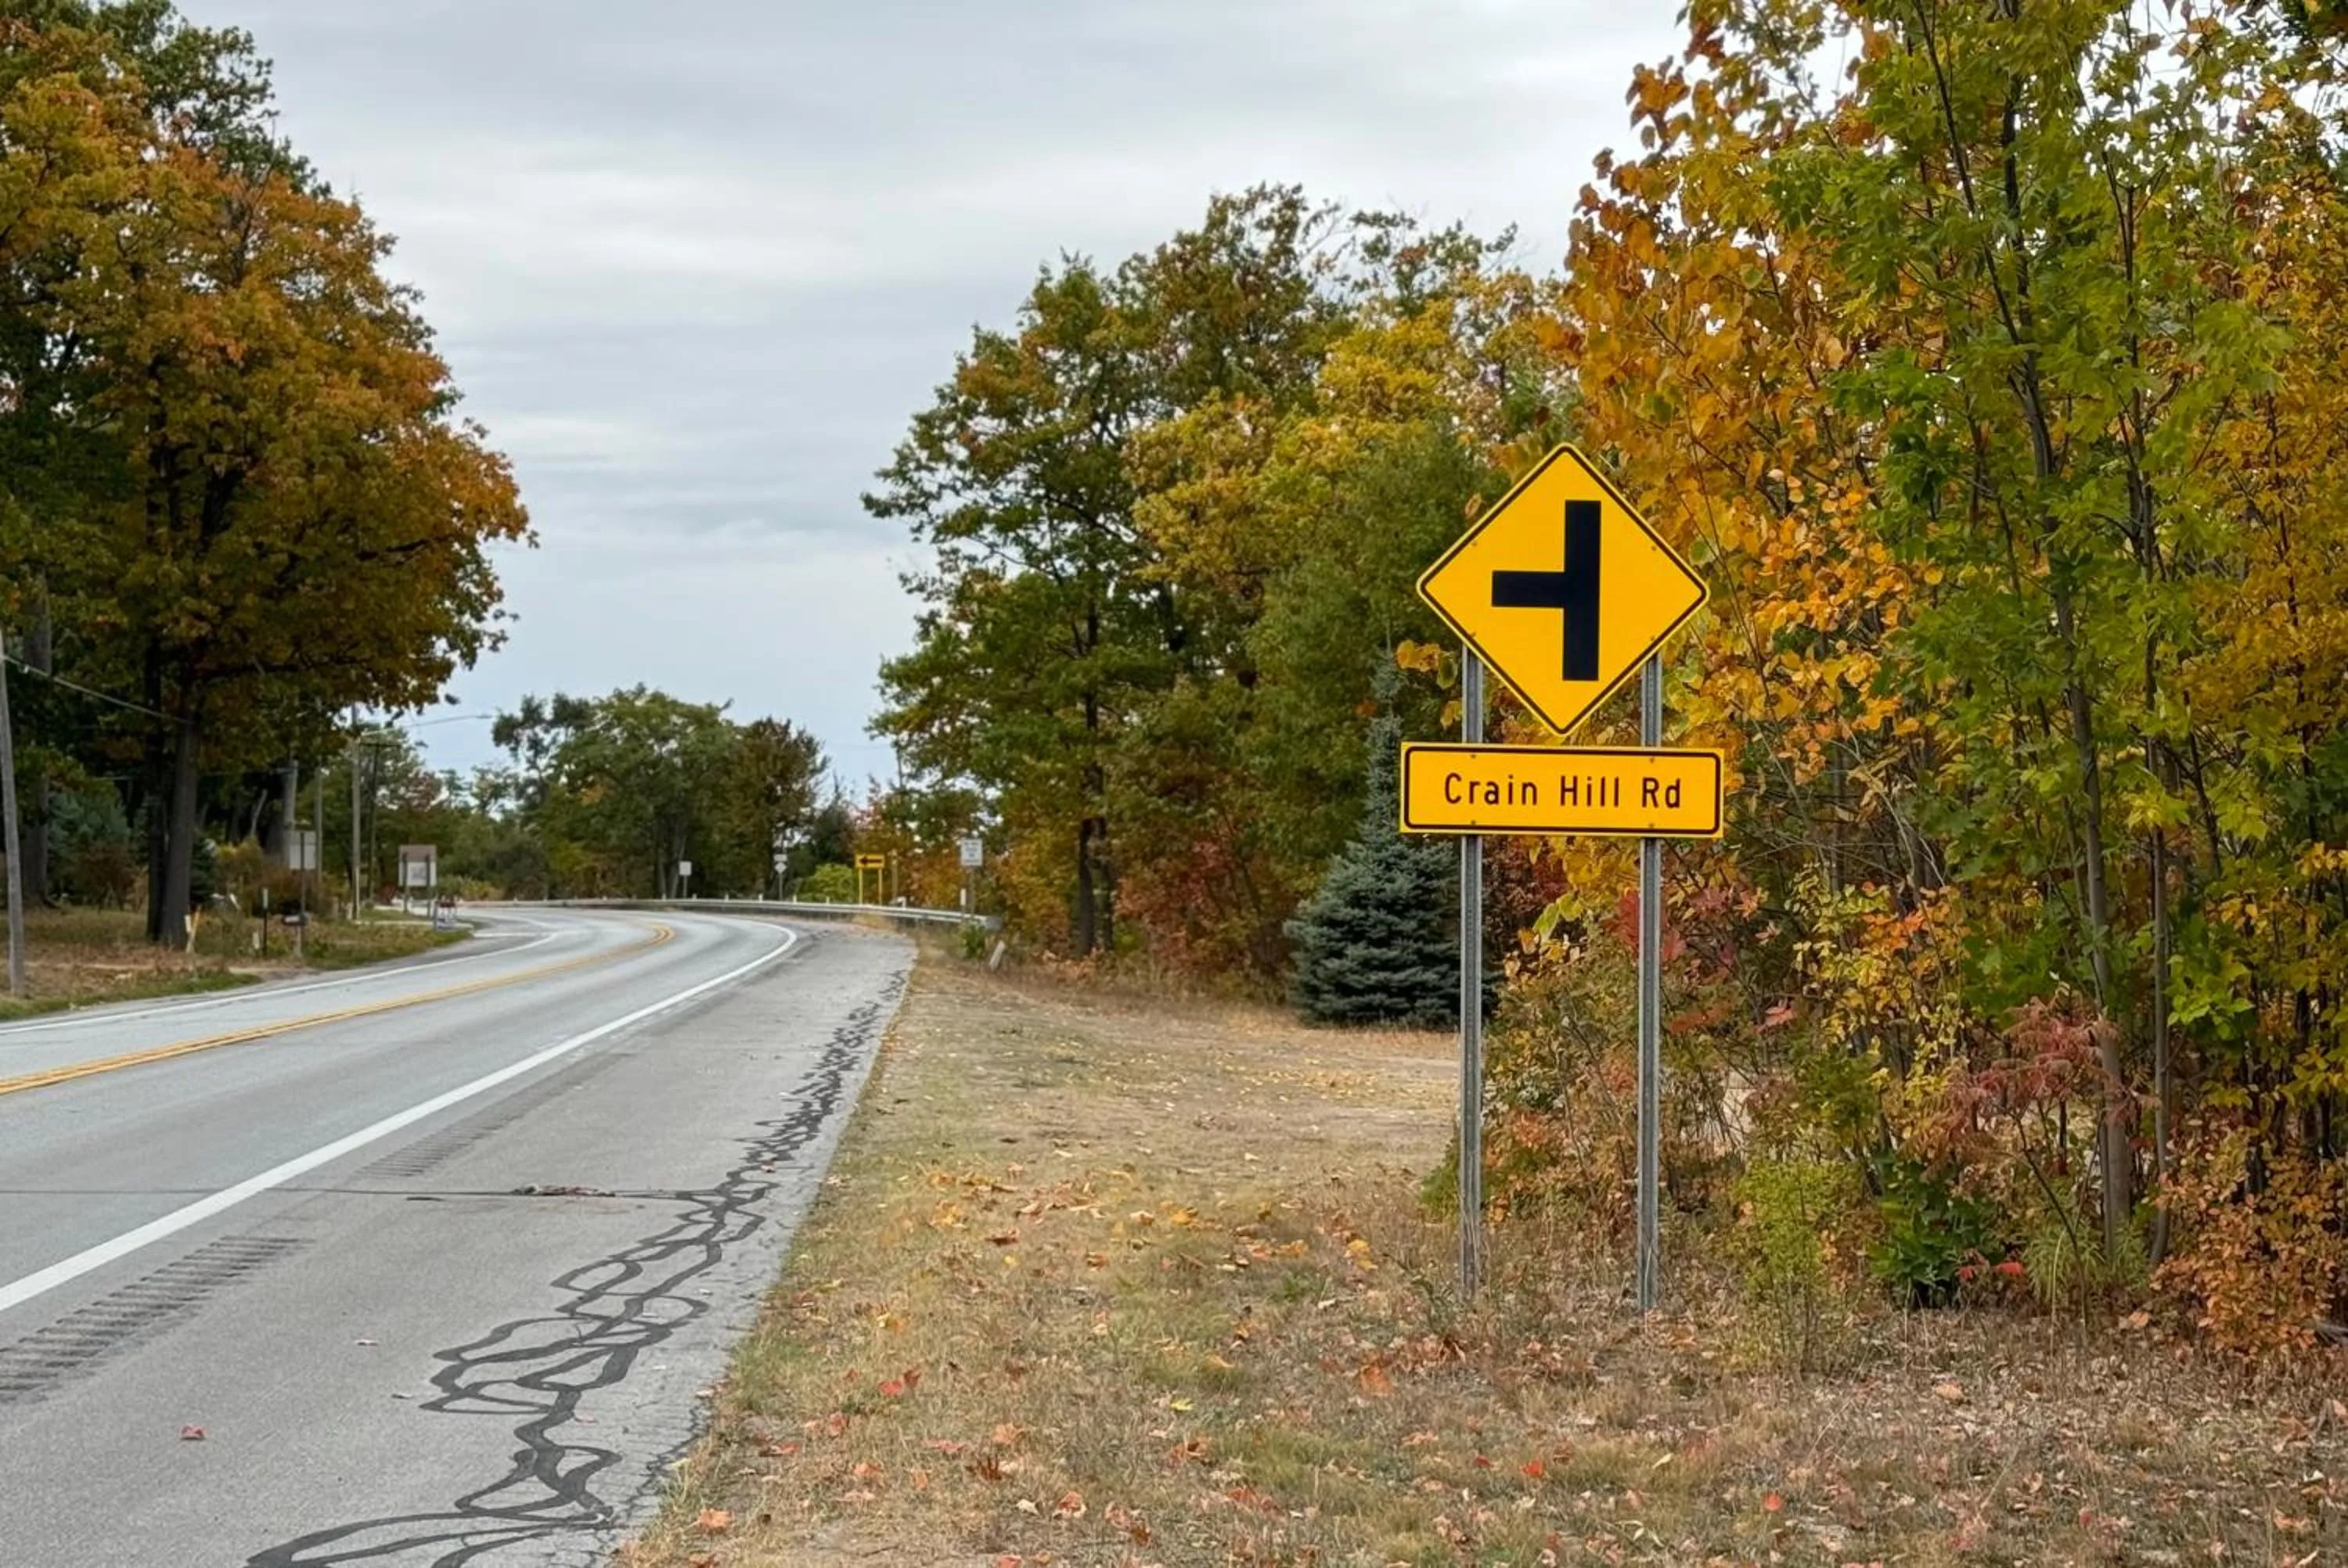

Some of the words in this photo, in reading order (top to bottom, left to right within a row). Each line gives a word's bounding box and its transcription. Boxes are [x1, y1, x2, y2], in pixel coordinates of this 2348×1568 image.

[1444, 772, 1538, 805] Crain
[1560, 775, 1619, 807] Hill
[1641, 777, 1681, 809] Rd
